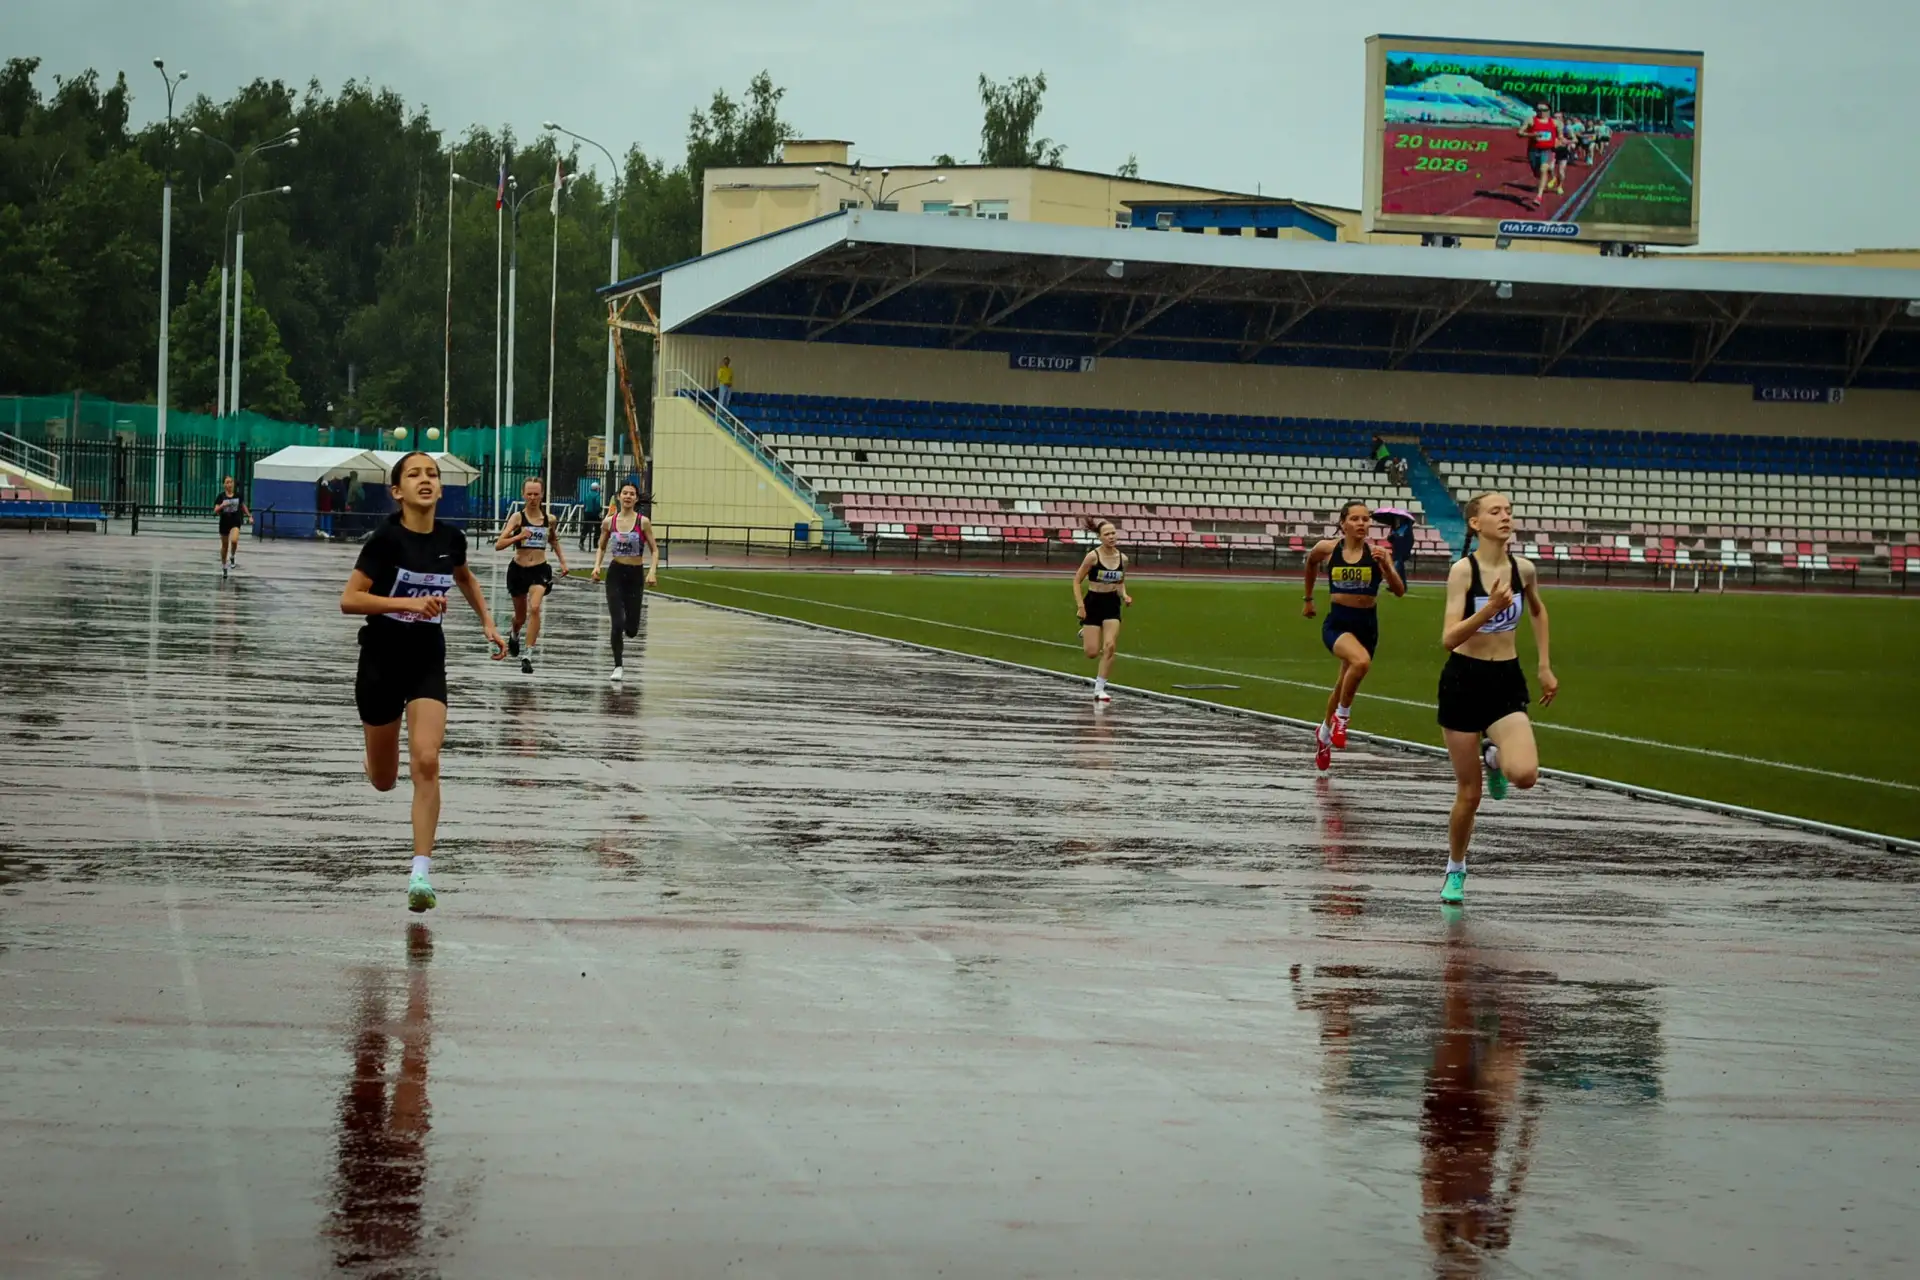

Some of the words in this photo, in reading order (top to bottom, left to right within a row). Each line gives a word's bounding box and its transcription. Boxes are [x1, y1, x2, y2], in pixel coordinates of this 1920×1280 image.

[1503, 81, 1525, 93] ПО
[1395, 134, 1423, 148] 20
[1428, 138, 1489, 152] июня
[1415, 156, 1469, 172] 2026
[1018, 355, 1074, 370] СЕКТОР
[1083, 357, 1093, 372] 7
[1761, 387, 1820, 400] СЕКТОР
[1342, 568, 1362, 581] 808
